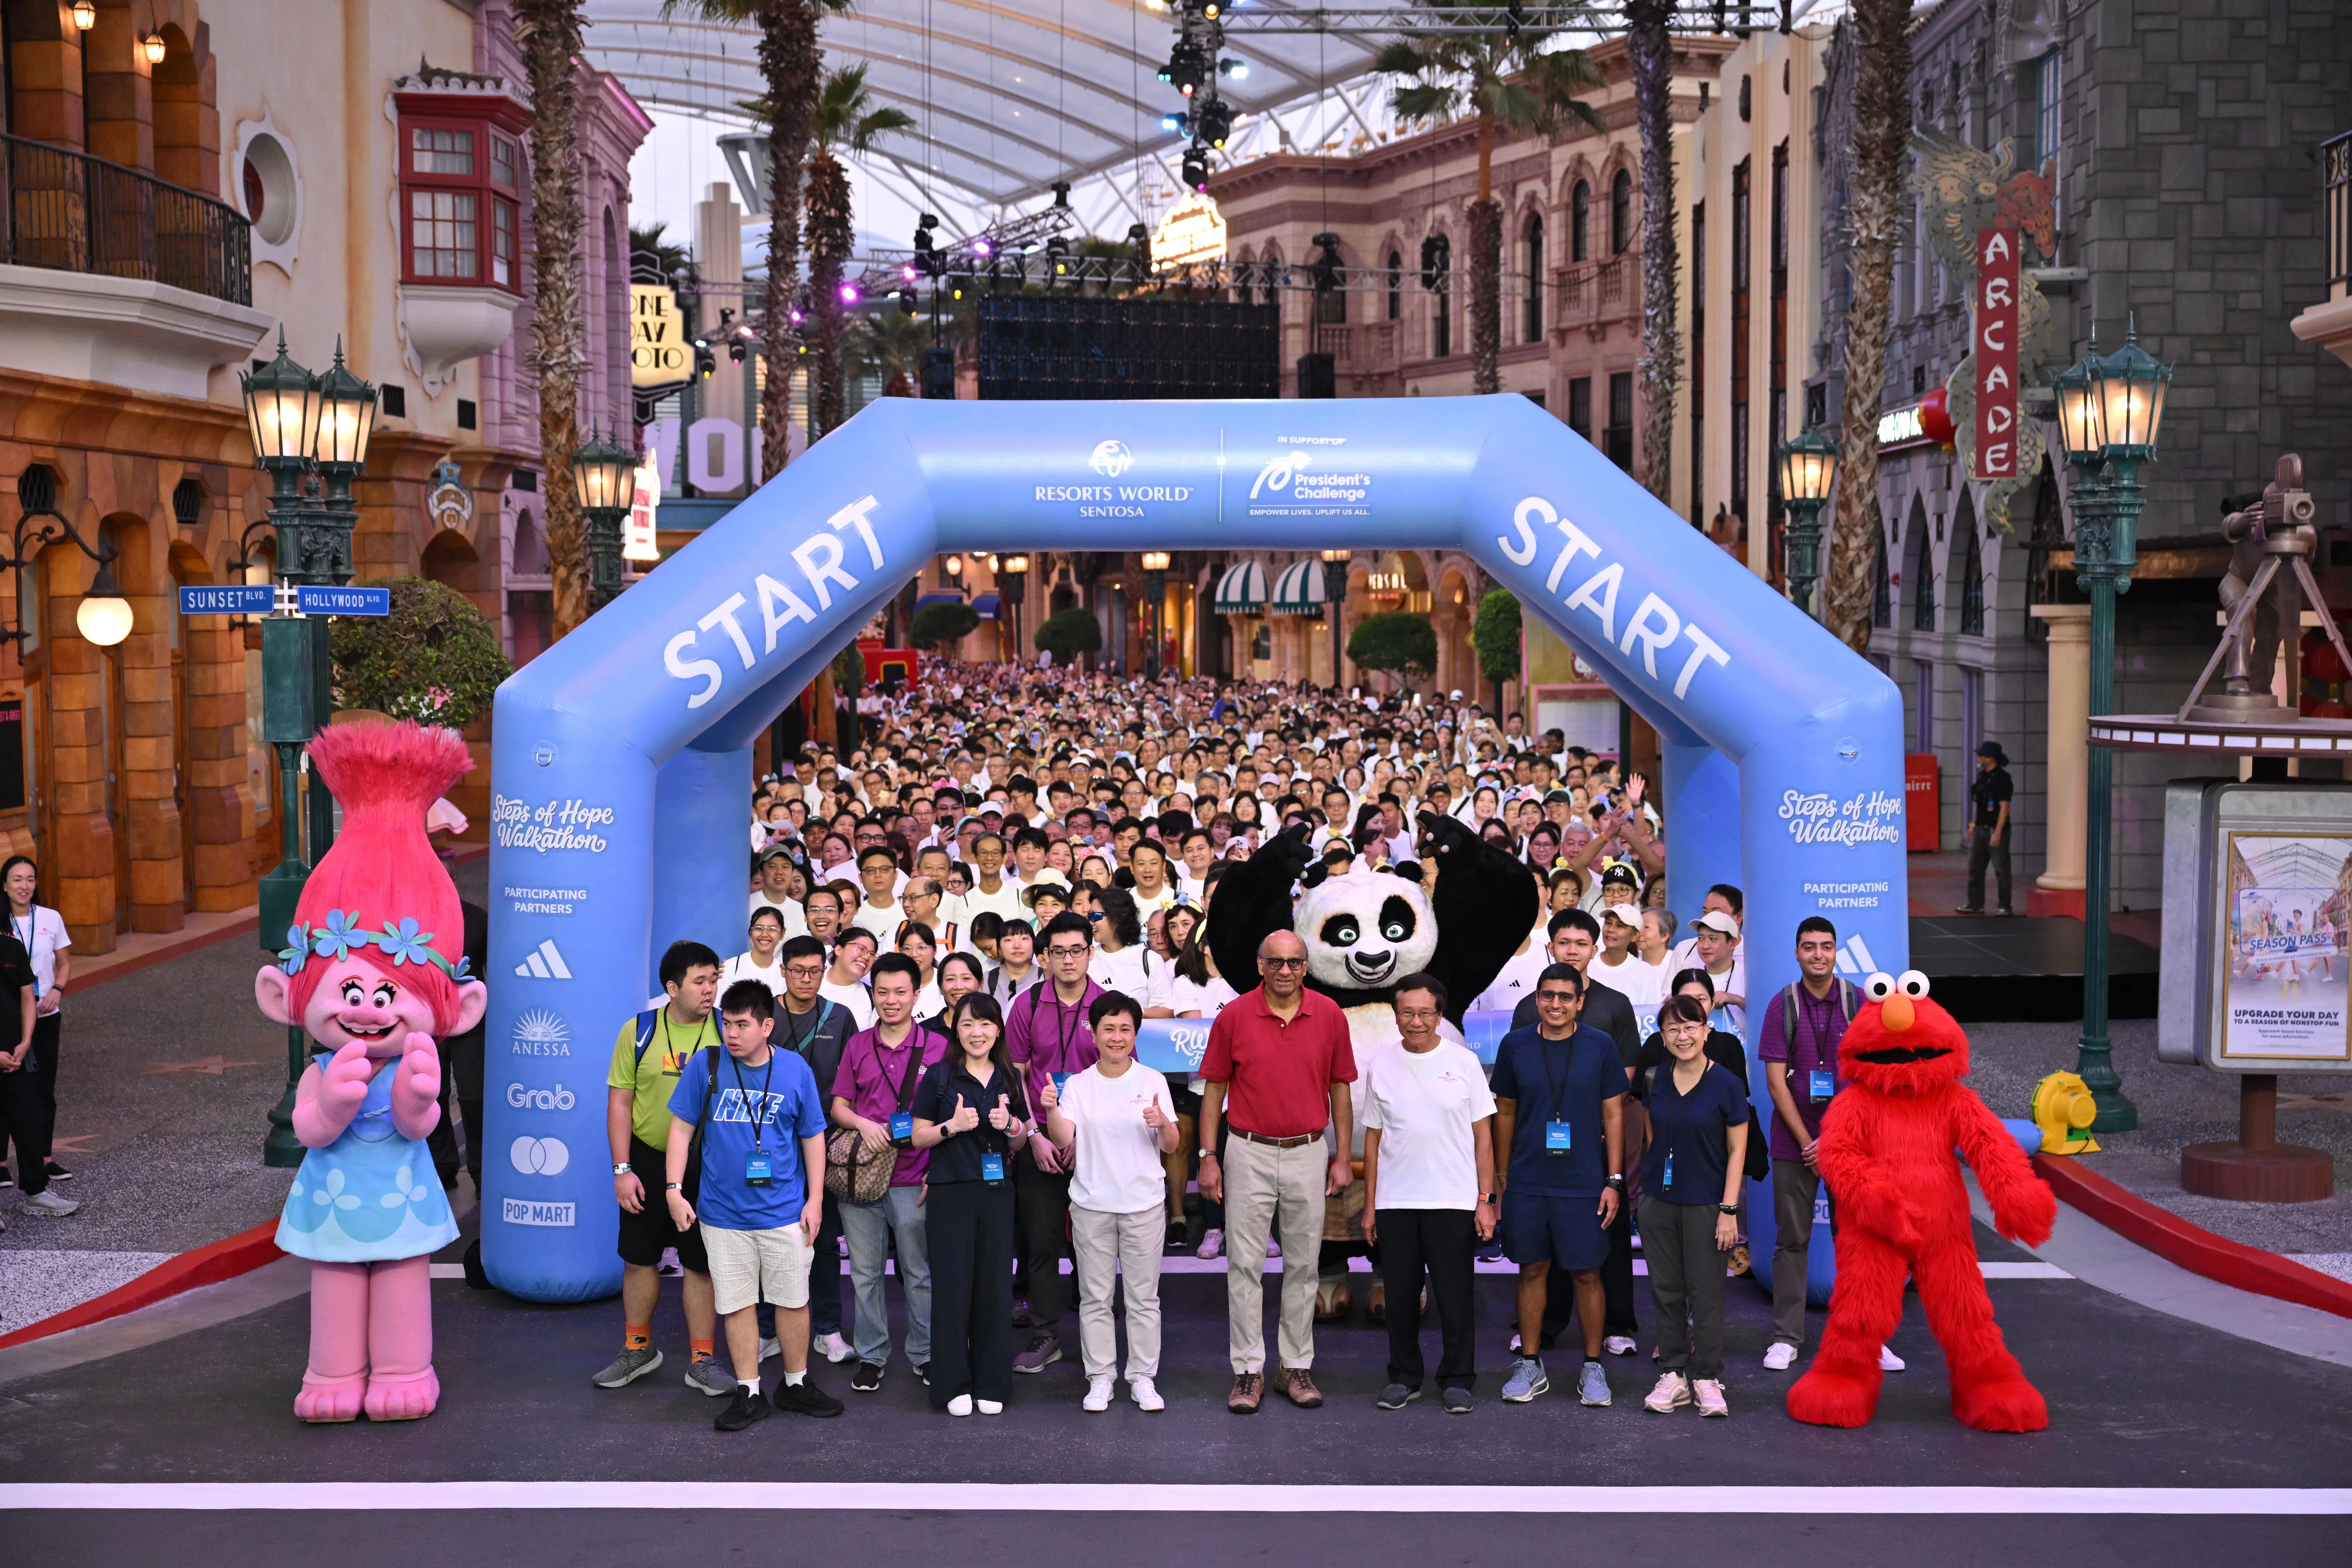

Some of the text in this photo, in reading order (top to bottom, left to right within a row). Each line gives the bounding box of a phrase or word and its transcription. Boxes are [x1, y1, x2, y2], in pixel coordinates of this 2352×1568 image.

[632, 346, 683, 369] OTO
[1983, 231, 2012, 473] ARCADE
[1295, 474, 1370, 485] President's
[1035, 487, 1112, 501] RESORTS
[1295, 487, 1366, 501] Challenge
[1080, 506, 1144, 517] SENTOSA
[188, 591, 266, 609] SUNSET BLVD.
[305, 593, 364, 607] HOLLYWOOD
[664, 494, 884, 708] START
[1497, 496, 1731, 700] START
[493, 794, 614, 830] Steps of Hope
[1778, 789, 1902, 823] Steps of Hope
[498, 823, 607, 855] Walkathon
[1789, 817, 1898, 849] Walkathon
[505, 887, 587, 900] PARTICIPATING
[1804, 882, 1889, 893] PARTICIPATING
[514, 903, 572, 914] PARTNERS
[1818, 897, 1878, 907] PARTNERS
[2250, 933, 2327, 950] SEASON PASS
[2234, 1010, 2284, 1018] UPGRADE
[513, 1041, 570, 1056] ANESSA
[1169, 1027, 1210, 1056] RW
[507, 1083, 575, 1110] Grab
[713, 1088, 784, 1124] NIKE
[506, 1203, 571, 1223] POP MART
[1813, 1203, 1830, 1220] PO
